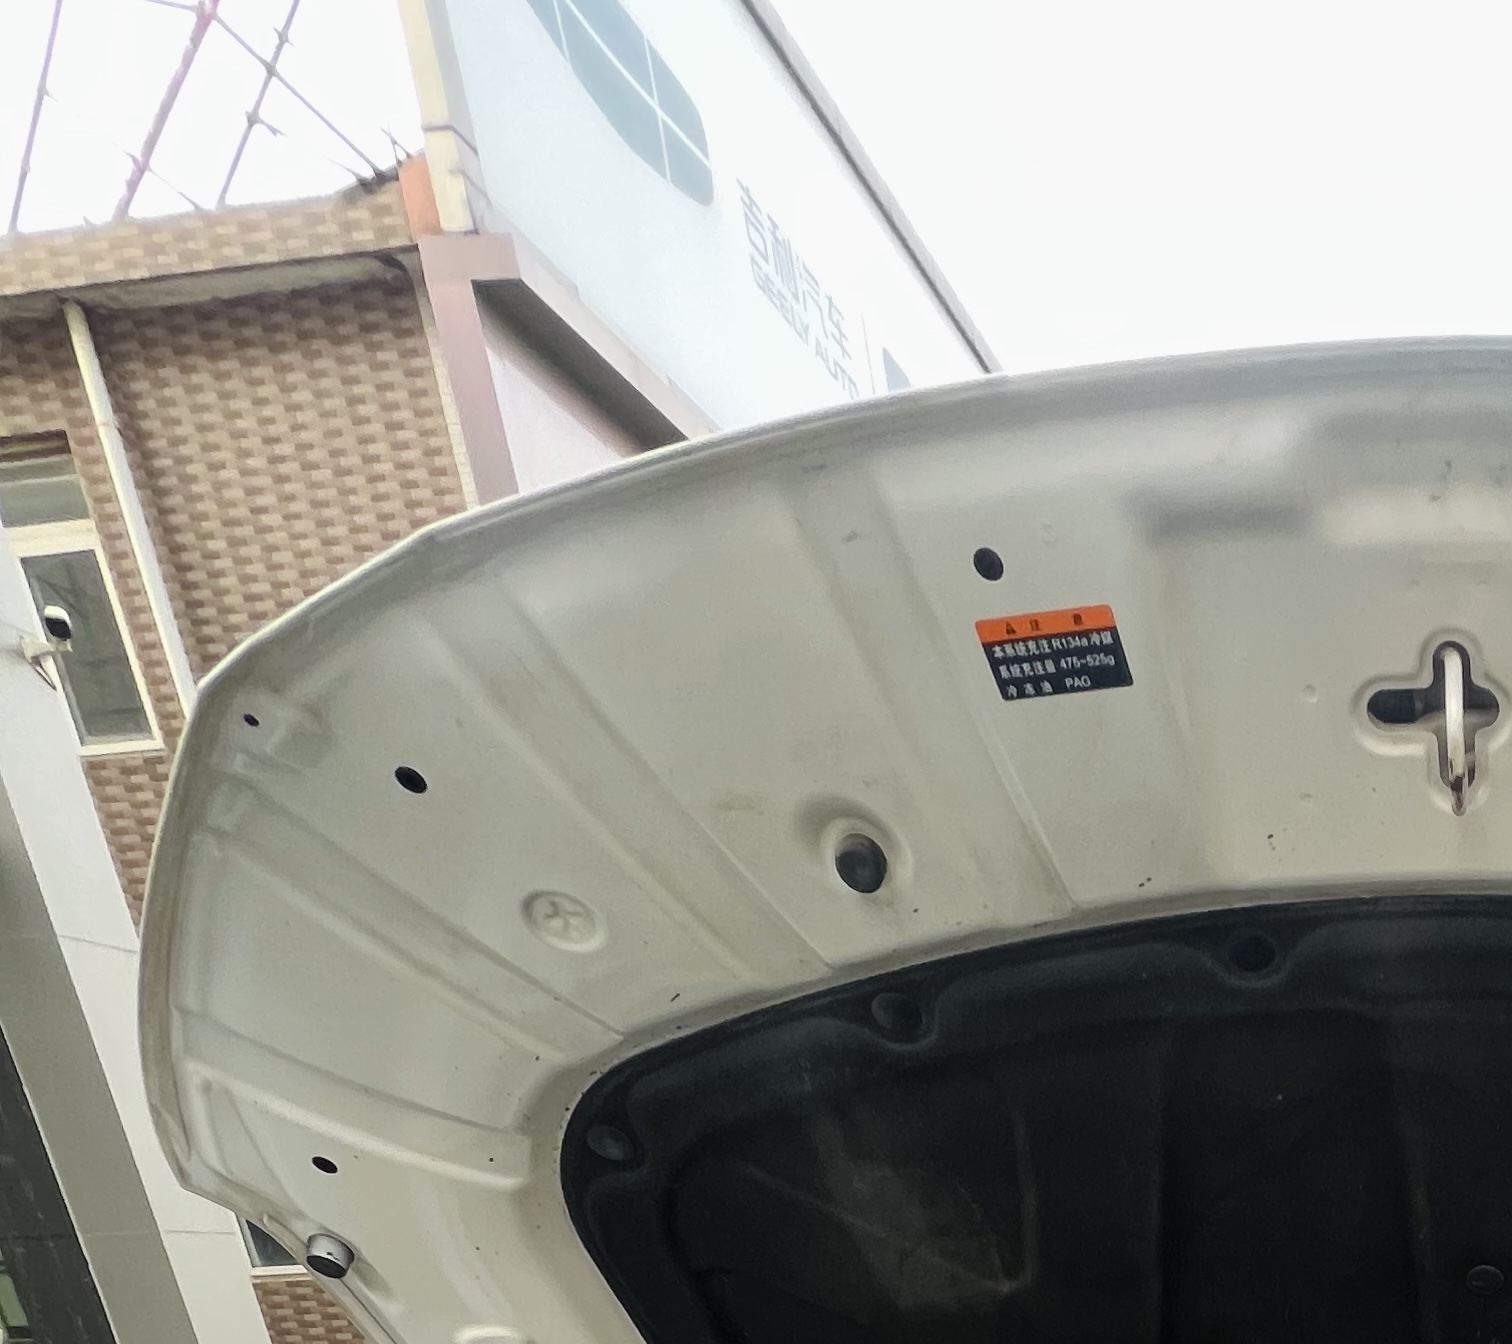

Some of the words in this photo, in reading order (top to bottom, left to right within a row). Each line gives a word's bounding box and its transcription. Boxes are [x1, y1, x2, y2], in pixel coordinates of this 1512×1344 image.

[735, 176, 853, 361] 吉利汽车
[748, 252, 810, 347] GEELY
